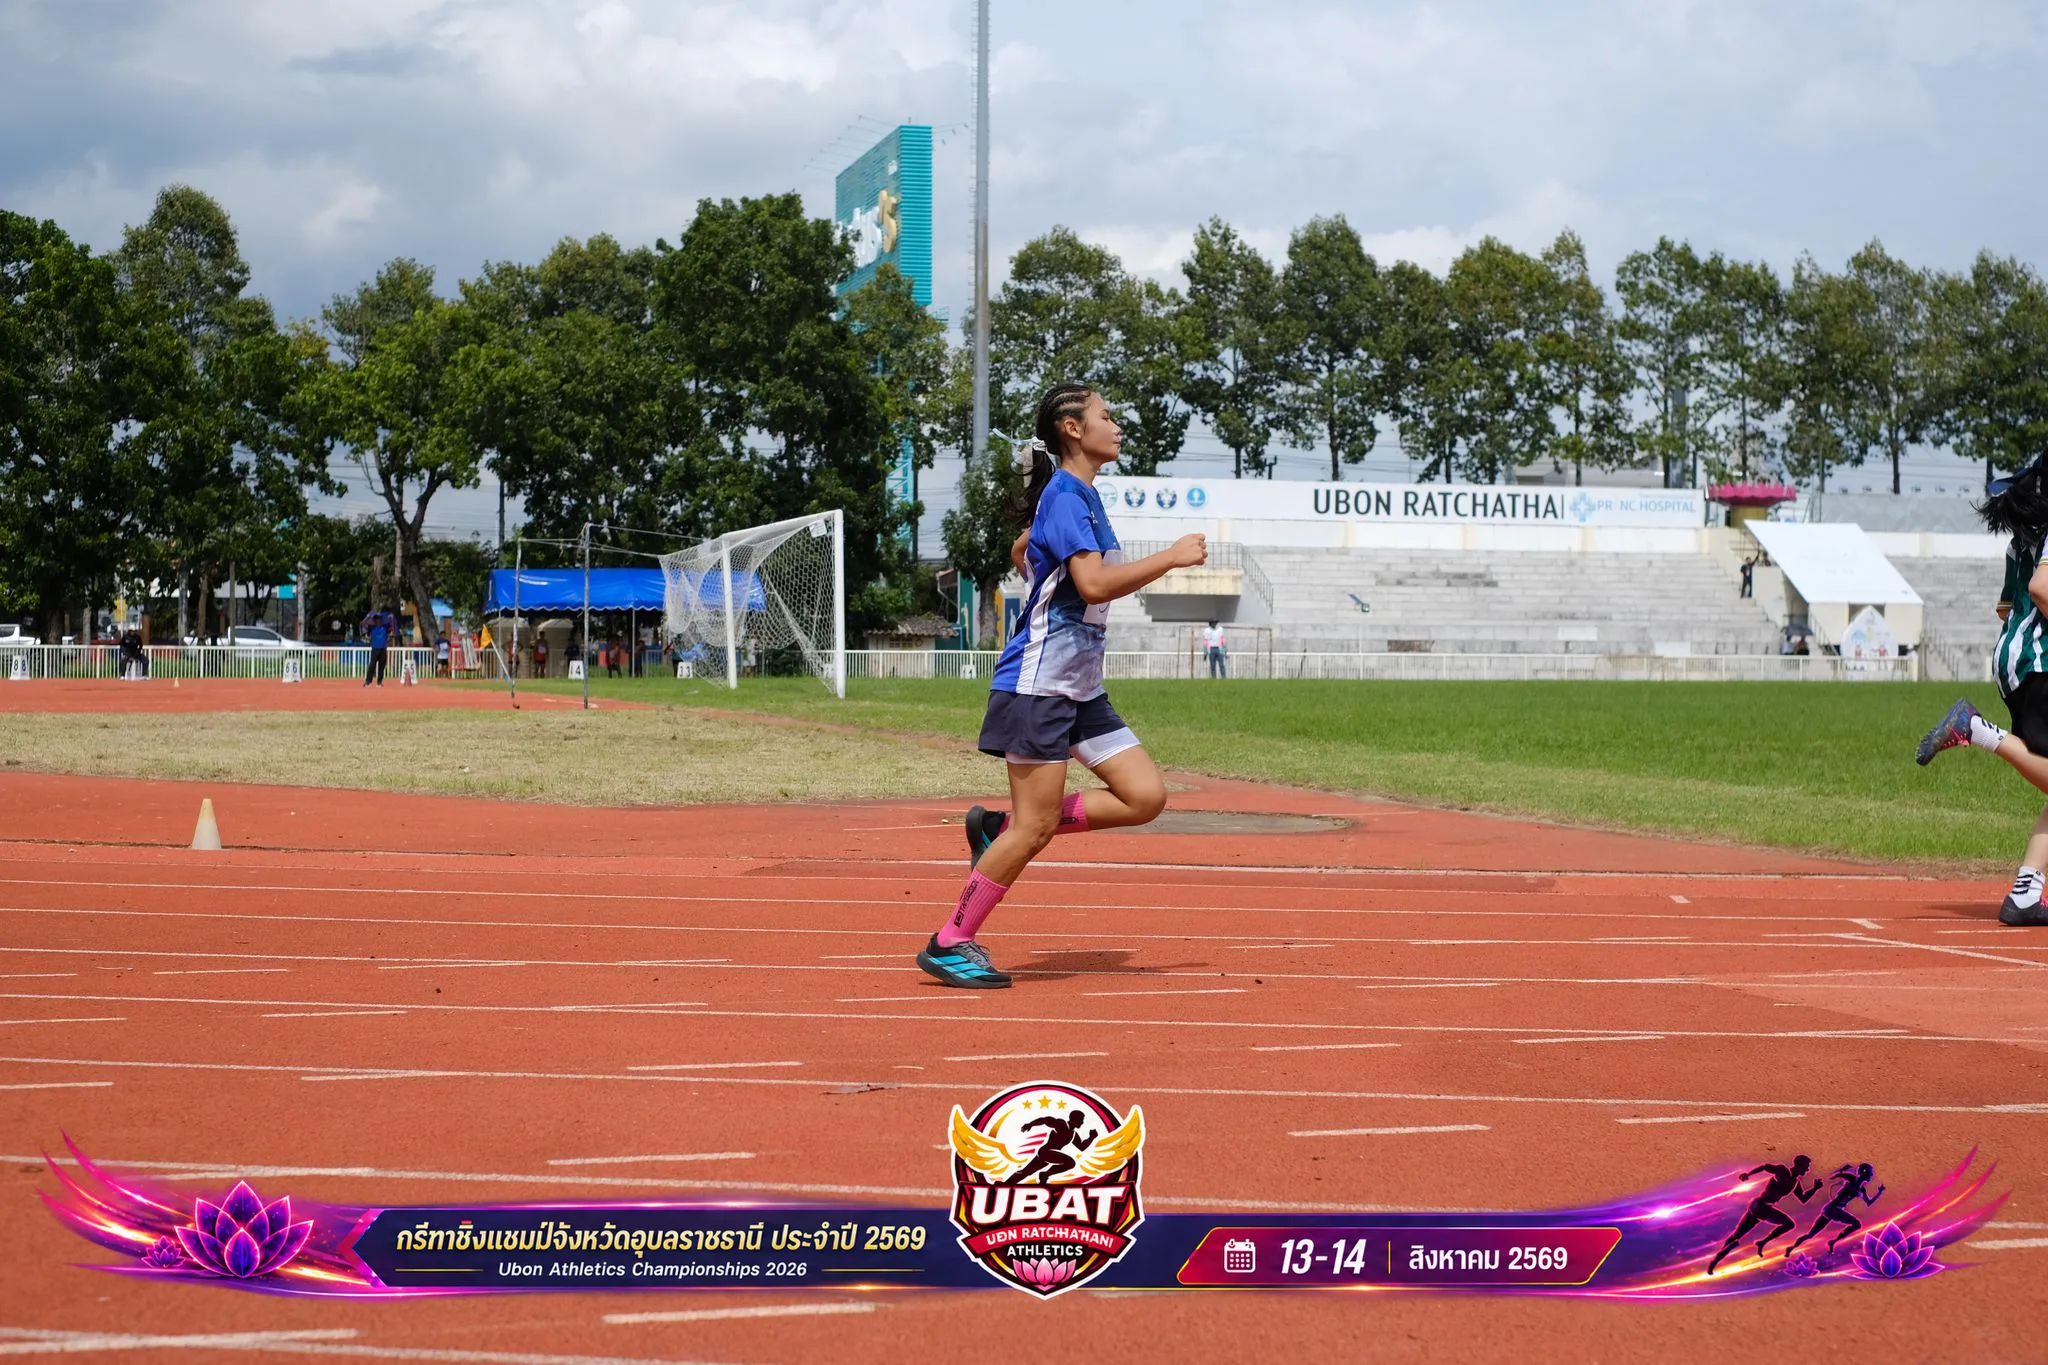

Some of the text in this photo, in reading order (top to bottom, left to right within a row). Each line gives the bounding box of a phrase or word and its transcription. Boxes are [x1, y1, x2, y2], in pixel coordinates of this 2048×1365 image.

[1314, 490, 1564, 519] UBON RATCHATHA
[1640, 500, 1696, 513] HOSPITAL
